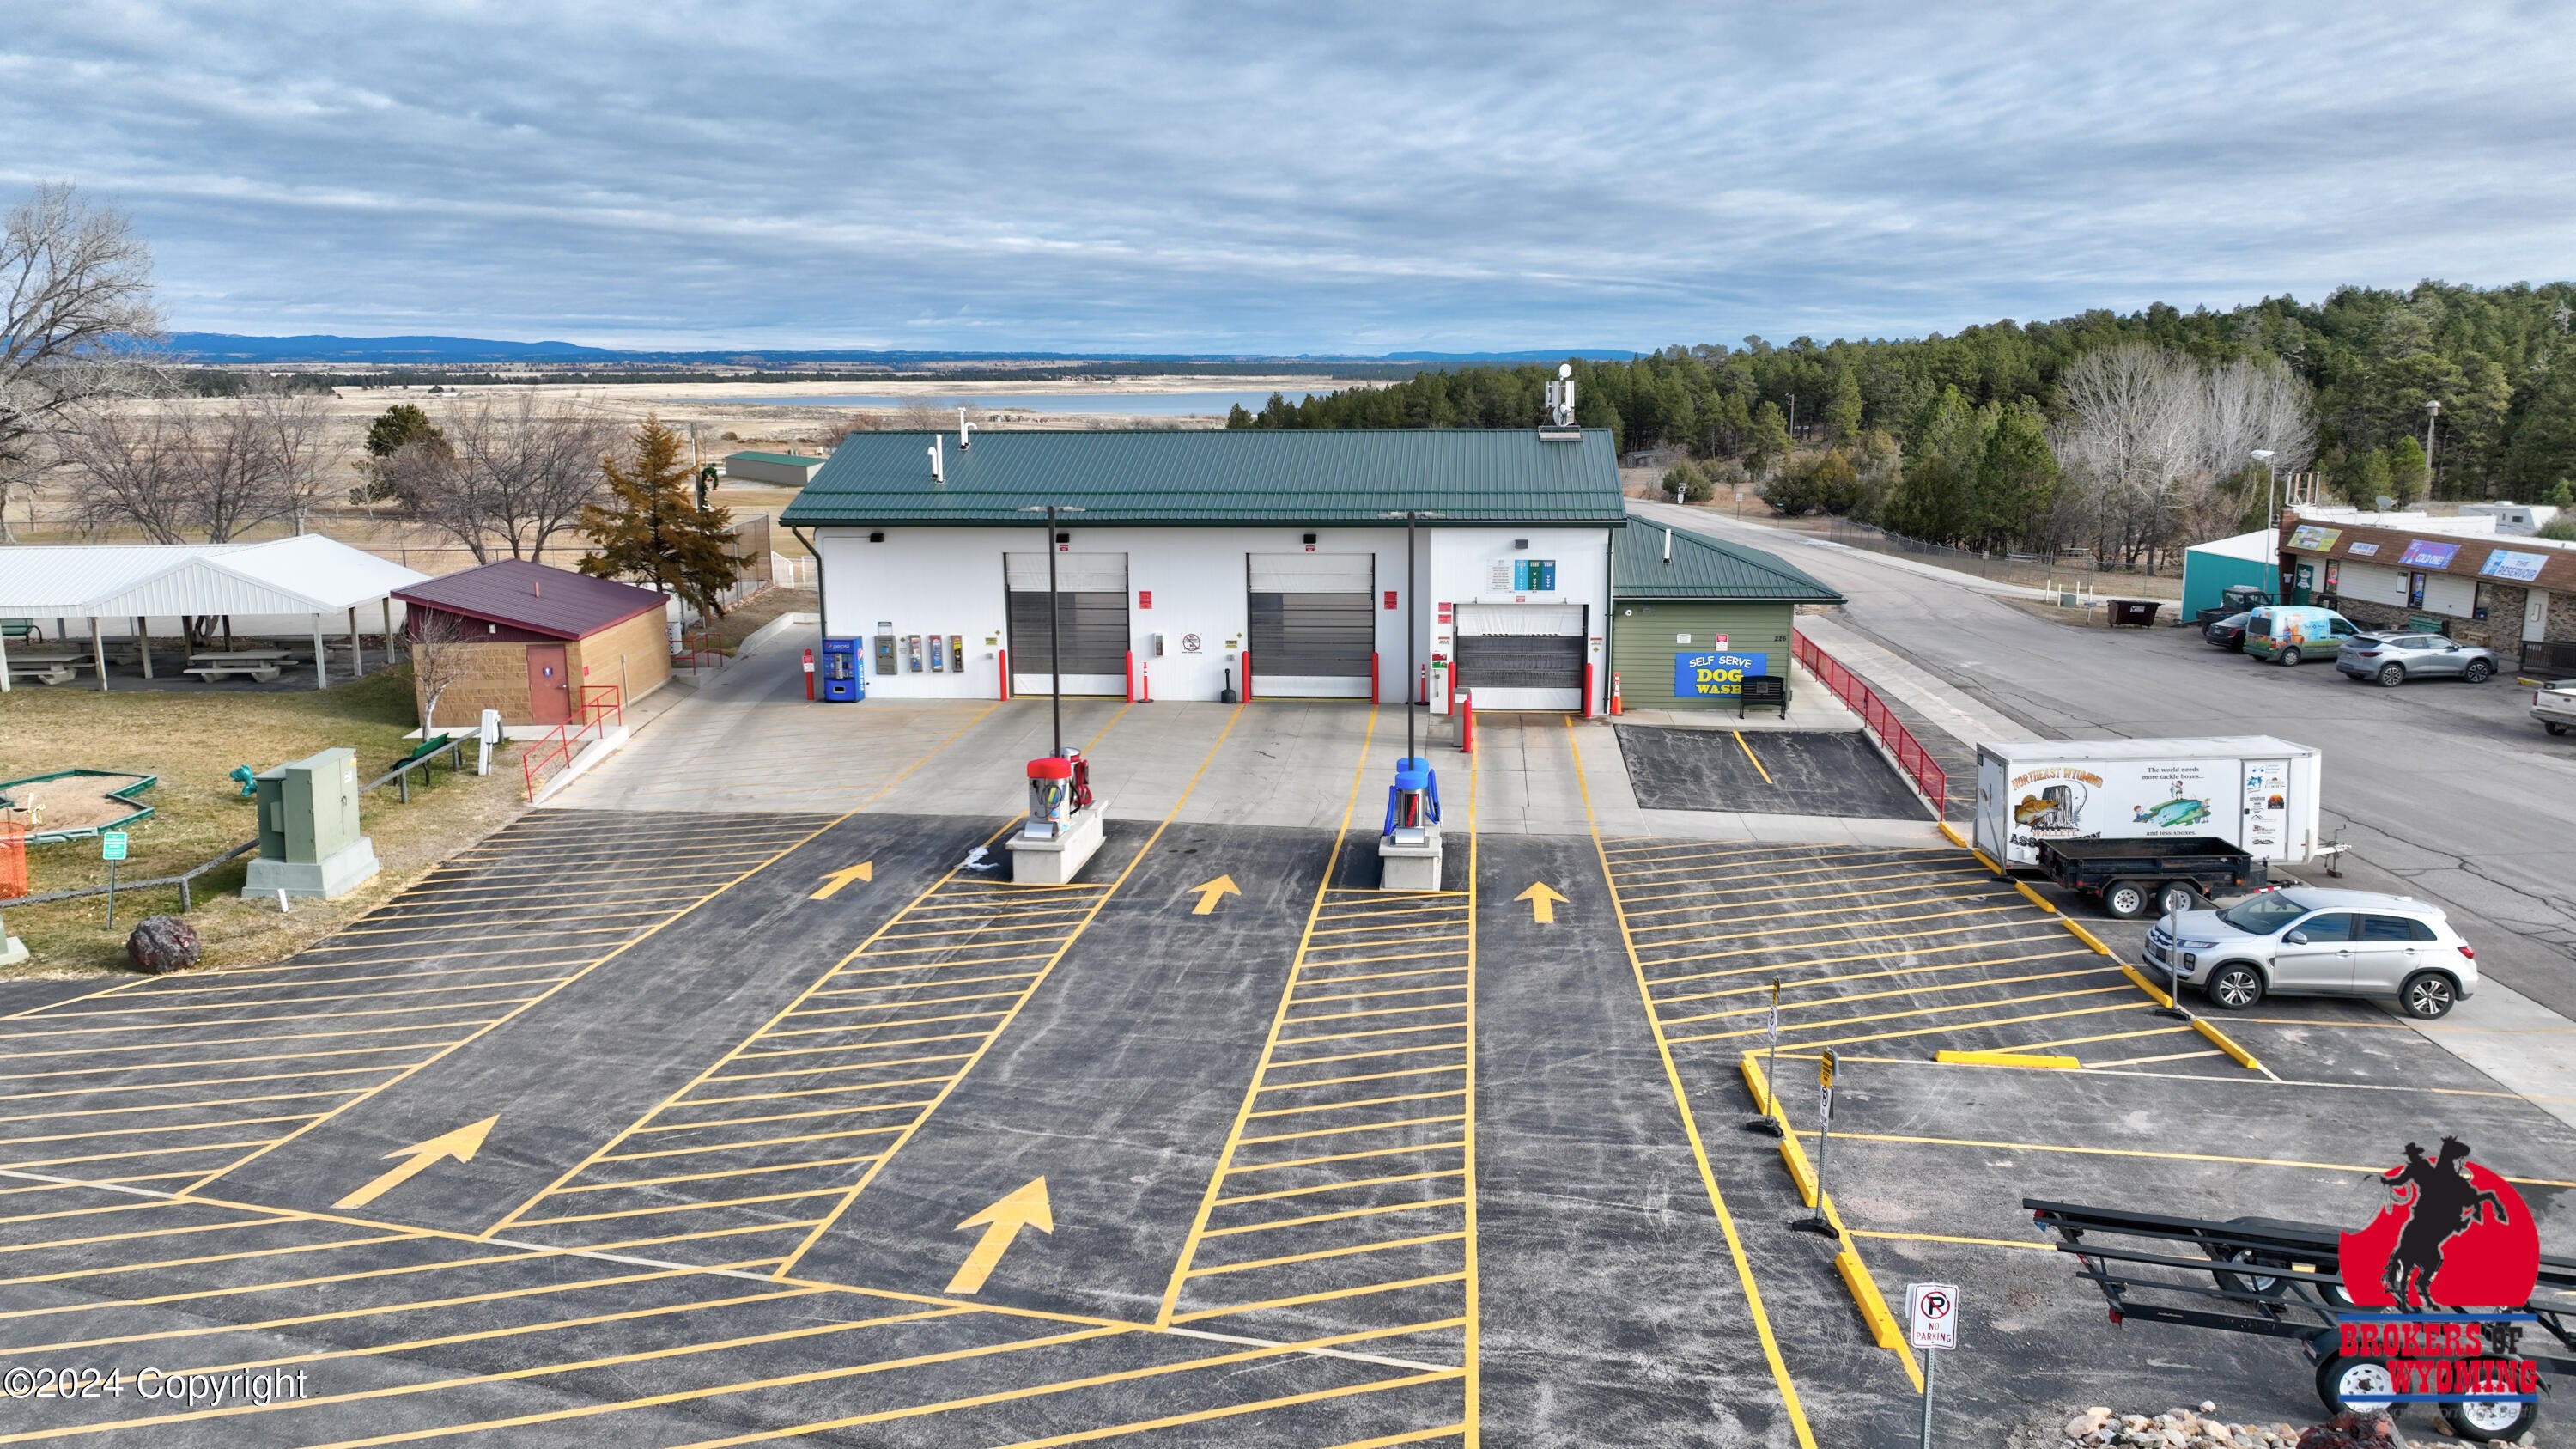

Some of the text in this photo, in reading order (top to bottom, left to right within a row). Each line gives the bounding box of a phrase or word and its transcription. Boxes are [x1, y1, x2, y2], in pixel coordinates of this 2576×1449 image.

[2497, 565, 2537, 580] RESERVOIR
[1689, 655, 1753, 668] SELF SERVE
[1696, 668, 1744, 682] DOG
[2011, 767, 2104, 790] NORTHEAST WYOMING
[1916, 1331, 1952, 1342] PARKING
